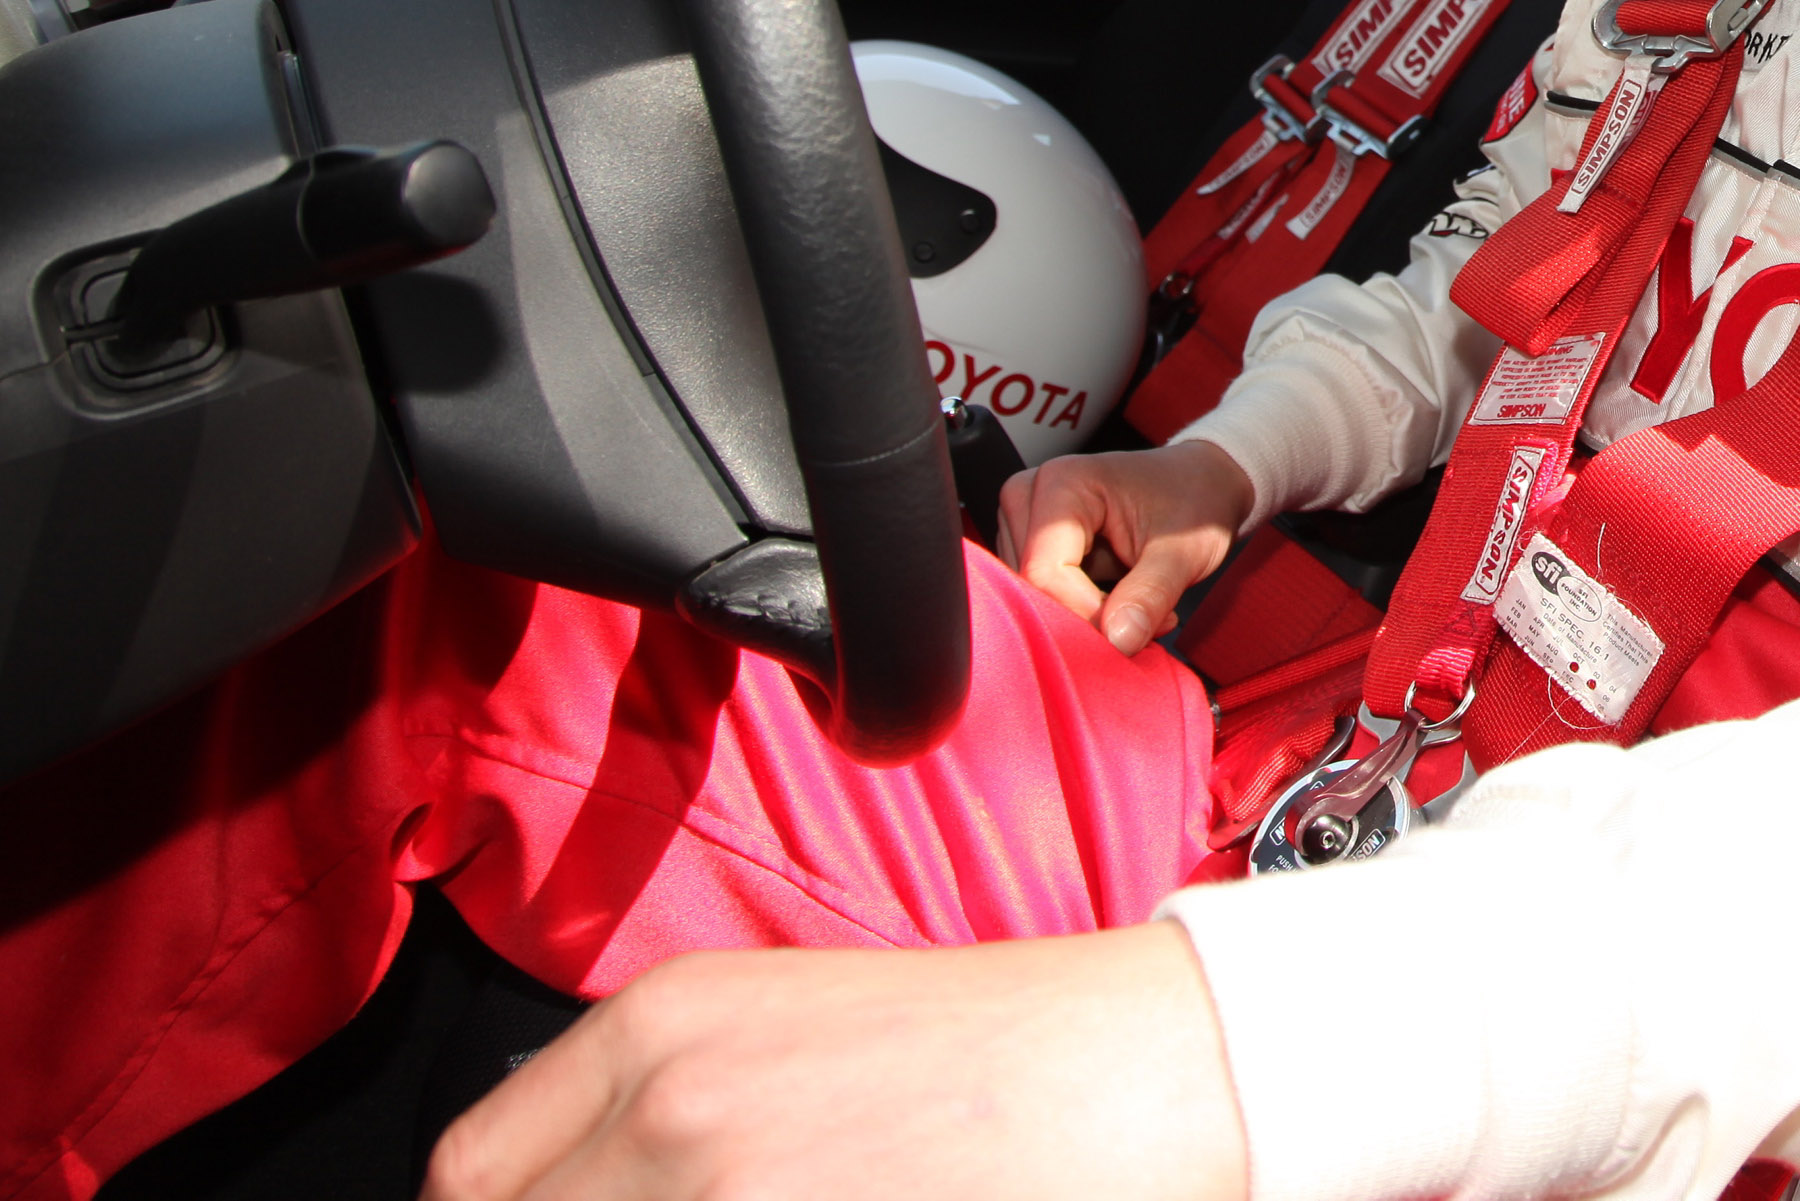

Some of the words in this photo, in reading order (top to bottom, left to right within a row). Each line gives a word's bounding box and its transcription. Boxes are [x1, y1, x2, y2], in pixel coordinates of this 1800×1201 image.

[1578, 89, 1635, 187] SIMPSON
[1497, 404, 1546, 417] SIMPSON
[1482, 466, 1527, 581] SIMPSON
[1535, 556, 1563, 584] sfi
[1561, 582, 1598, 617] FOUNDATION
[1568, 598, 1582, 612] INC.
[1578, 588, 1589, 599] SFI
[1506, 615, 1518, 629] MAR
[1524, 635, 1535, 647] JUN
[1510, 606, 1522, 619] FEB
[1528, 624, 1541, 638] MAY
[1546, 643, 1559, 656] AUG
[1515, 598, 1526, 610] JAN
[1533, 616, 1545, 629] APR
[1552, 635, 1563, 647] JUL
[1572, 652, 1585, 665] OCT
[1540, 597, 1557, 614] SFI
[1557, 613, 1585, 641] SPEC.
[1588, 640, 1610, 661] 16.1
[1606, 613, 1618, 626] This
[1543, 612, 1556, 627] Date
[1566, 632, 1598, 663] Manufacture
[1603, 632, 1624, 653] Product
[1275, 854, 1293, 872] PUSH
